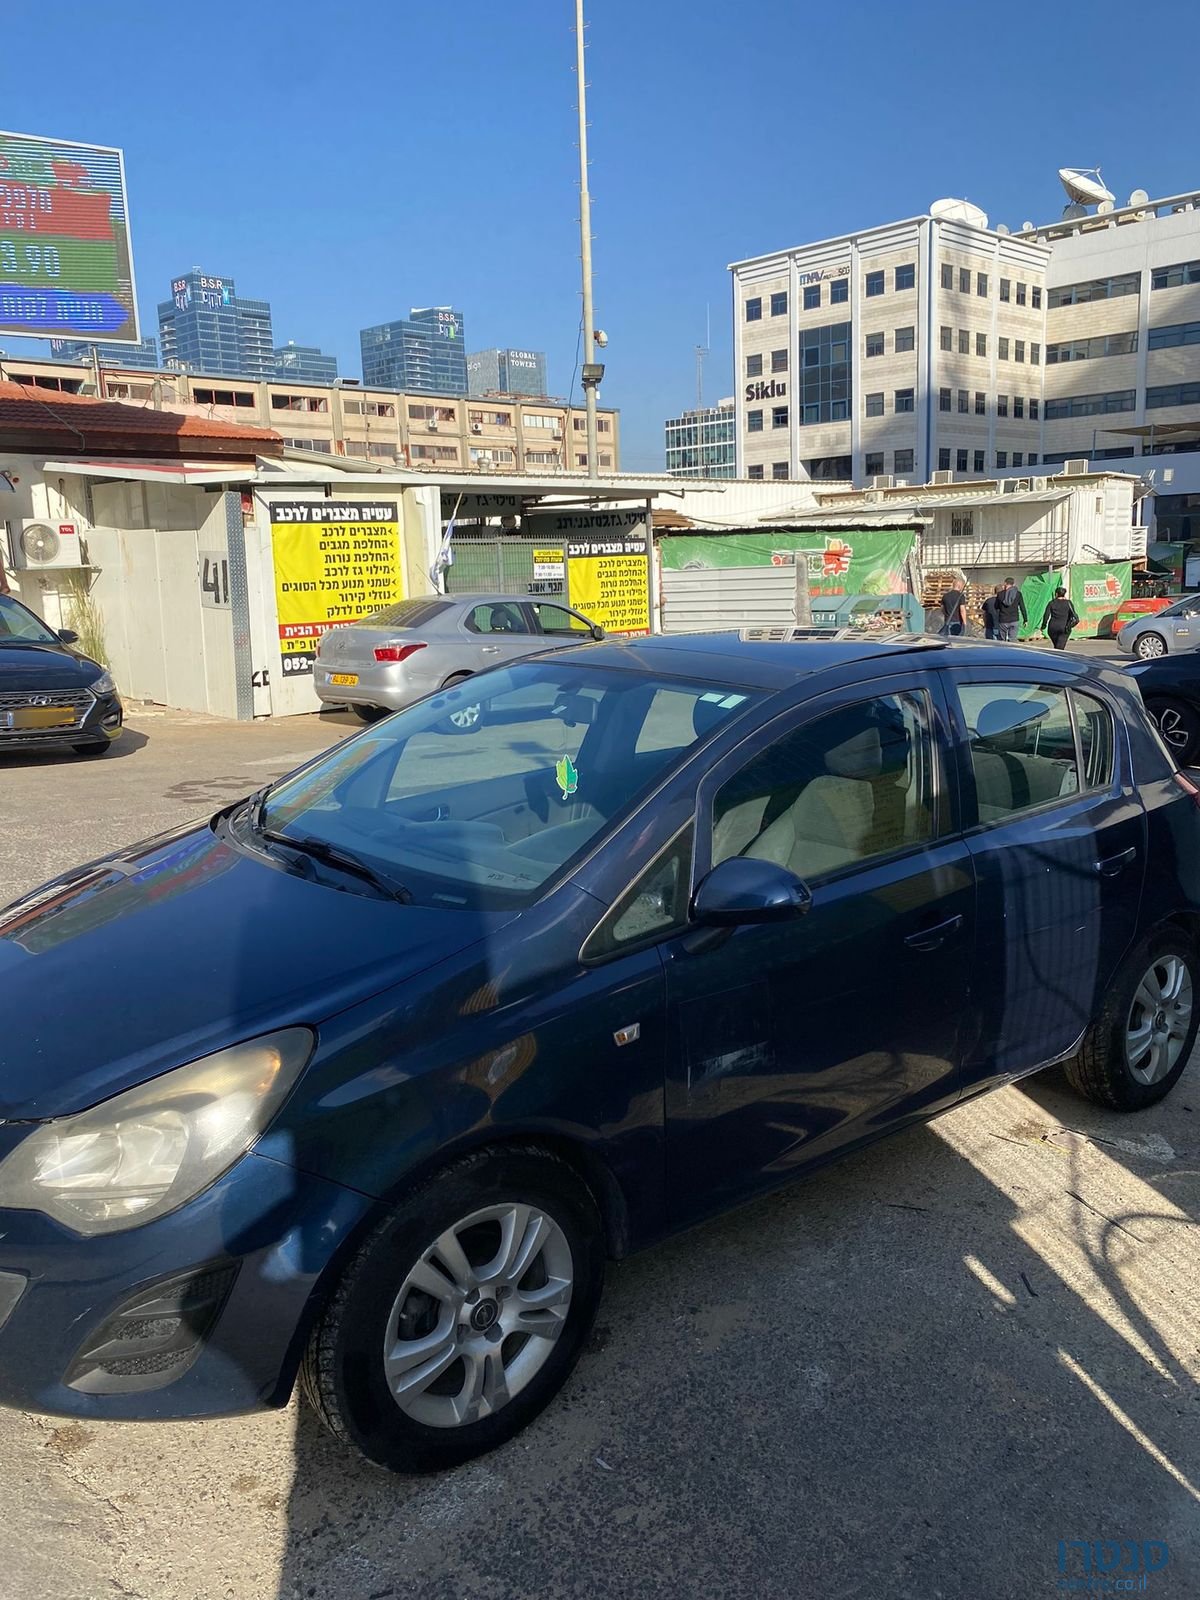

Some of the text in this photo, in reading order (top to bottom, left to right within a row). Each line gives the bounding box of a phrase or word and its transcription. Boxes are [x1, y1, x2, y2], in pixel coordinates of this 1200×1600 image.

[510, 350, 537, 360] GLOBAL
[510, 360, 537, 369] TOWERS
[745, 379, 786, 402] Siklu
[276, 506, 309, 521] לרכב
[312, 507, 359, 521] מצברים
[321, 526, 387, 537] מצברים לרכב
[319, 538, 388, 551] החלפת מגבים
[568, 543, 590, 554] לרכב
[591, 543, 623, 554] מצברים
[324, 551, 389, 564] החלפת נורות
[324, 564, 390, 577] מילוי גז לרכב
[282, 577, 391, 593] שמני מנוע מכל הסוגים
[339, 592, 365, 603] קירור
[326, 604, 352, 618] לדלק
[285, 625, 313, 637] הבית
